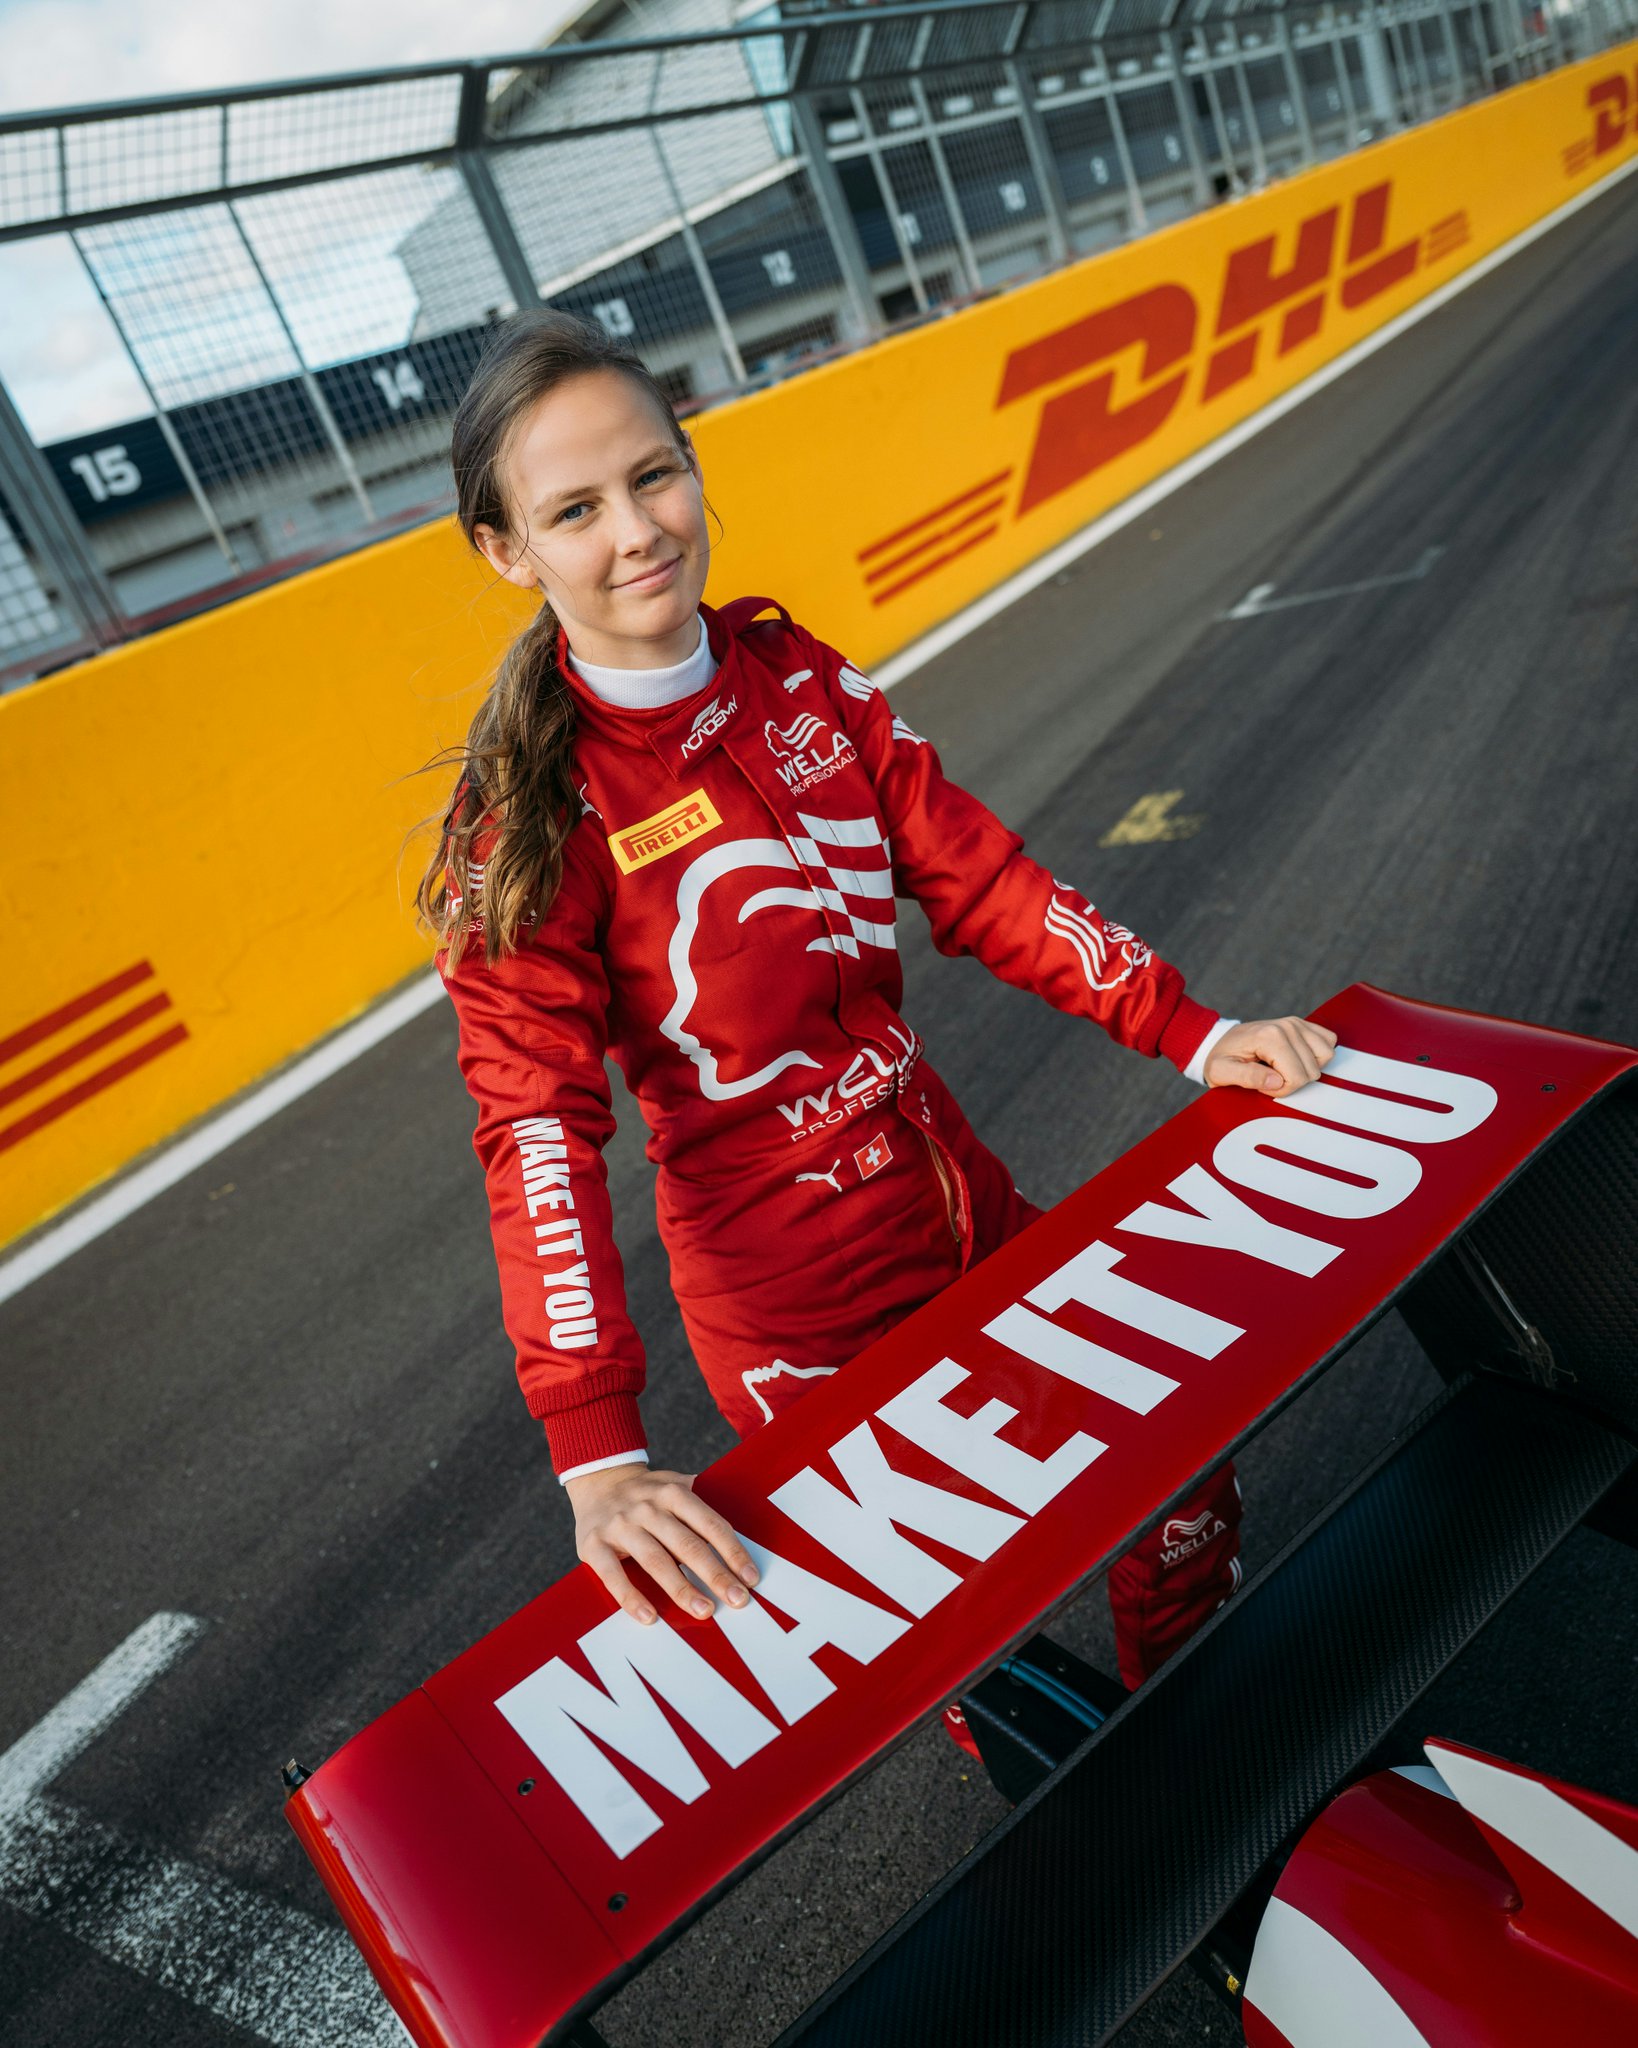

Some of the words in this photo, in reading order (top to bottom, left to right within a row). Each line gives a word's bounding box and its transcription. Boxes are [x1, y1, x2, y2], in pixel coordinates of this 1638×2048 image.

[762, 249, 797, 288] 12
[593, 298, 635, 337] 13
[994, 180, 1422, 521] DHL
[372, 361, 424, 410] 14
[70, 444, 142, 503] 15
[619, 801, 708, 863] PIRELLI
[511, 1117, 575, 1218] MAKE
[534, 1218, 585, 1257] IT
[543, 1260, 599, 1350] YOU
[494, 1356, 1109, 1859] MAKE
[981, 1240, 1247, 1416] IT
[1115, 1045, 1498, 1278] YOU
[1160, 1520, 1228, 1563] WELLA
